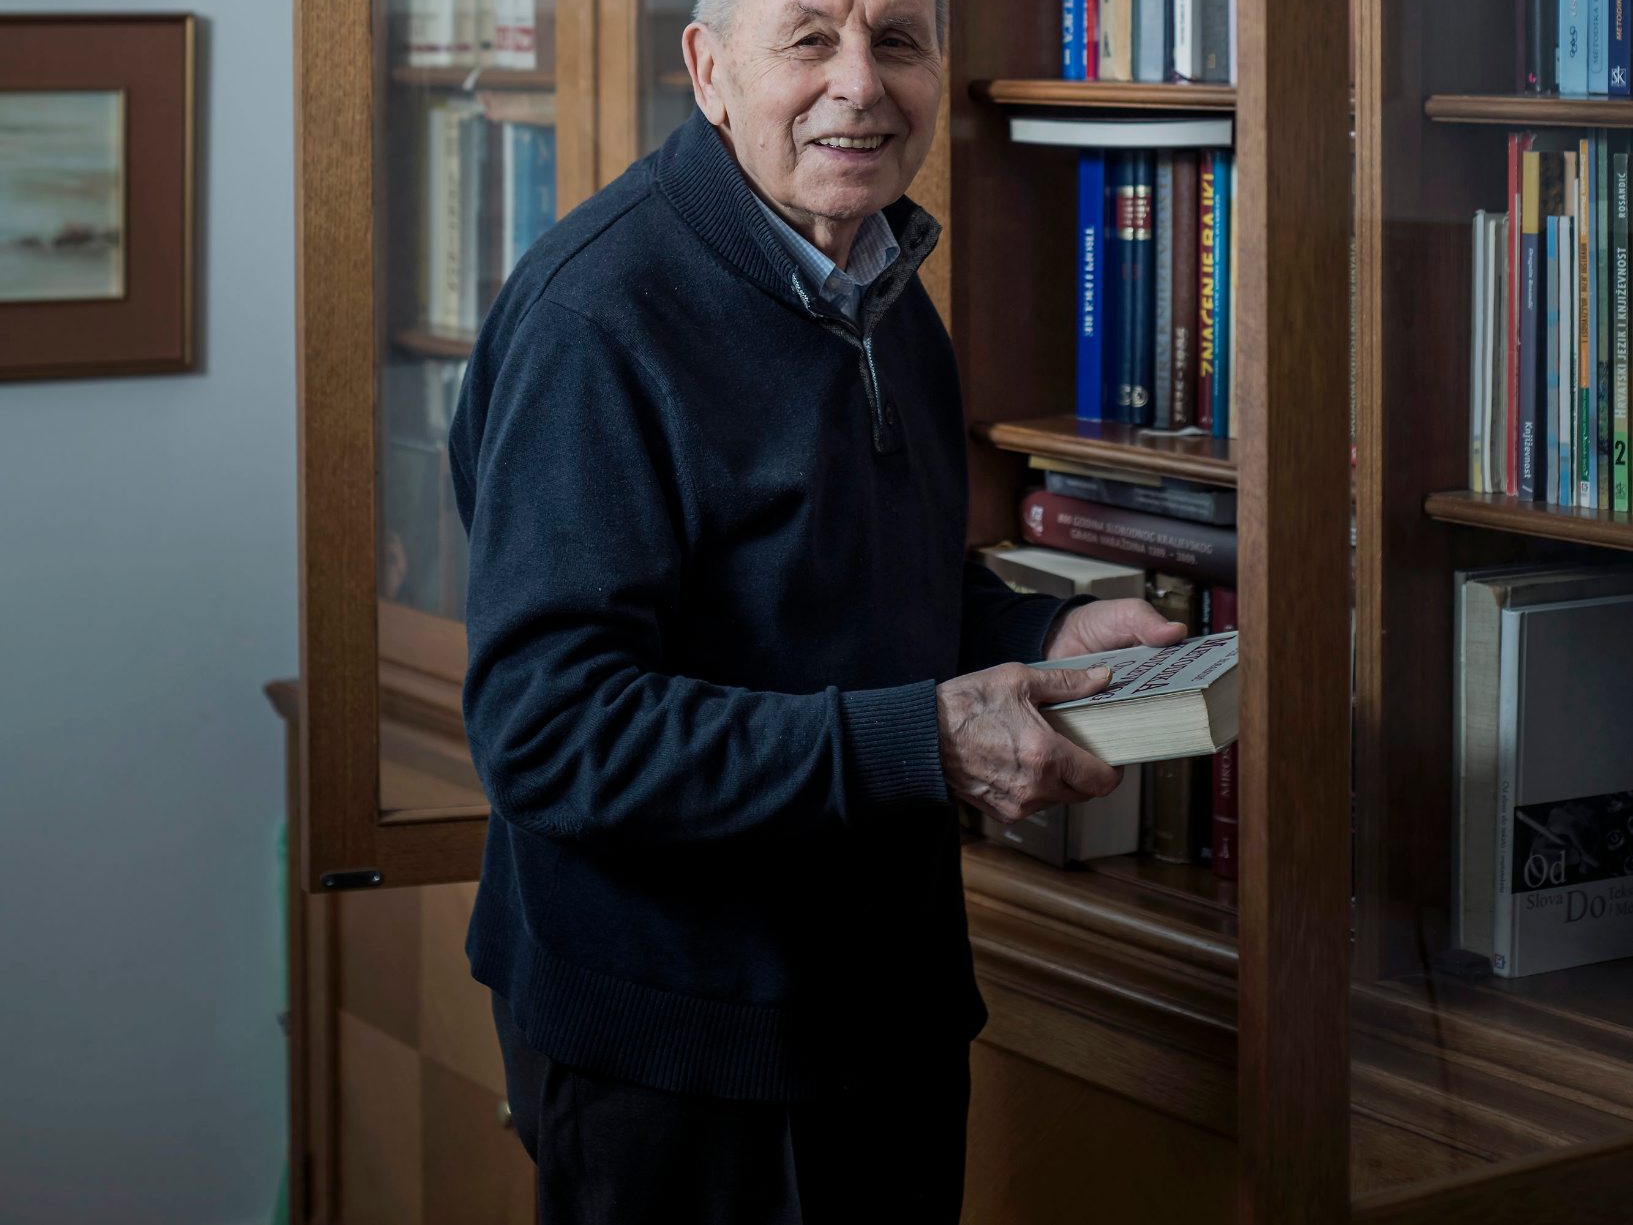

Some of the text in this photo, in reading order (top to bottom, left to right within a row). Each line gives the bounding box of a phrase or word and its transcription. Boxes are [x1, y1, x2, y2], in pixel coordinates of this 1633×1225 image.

[1592, 7, 1600, 65] METODIKA
[1617, 172, 1626, 220] ROSANDIĆ
[1614, 247, 1627, 321] KNJIŽEVNOST
[1616, 332, 1627, 361] JEZIK
[1614, 363, 1627, 419] HRVATSKI
[1523, 421, 1533, 478] Književnost
[1614, 440, 1626, 466] 2
[1099, 534, 1146, 554] VARAŽDINA
[1157, 533, 1214, 557] KRALJEVSKOG
[1524, 849, 1567, 889] Od
[1526, 893, 1564, 911] Slova
[1564, 890, 1606, 924] Do
